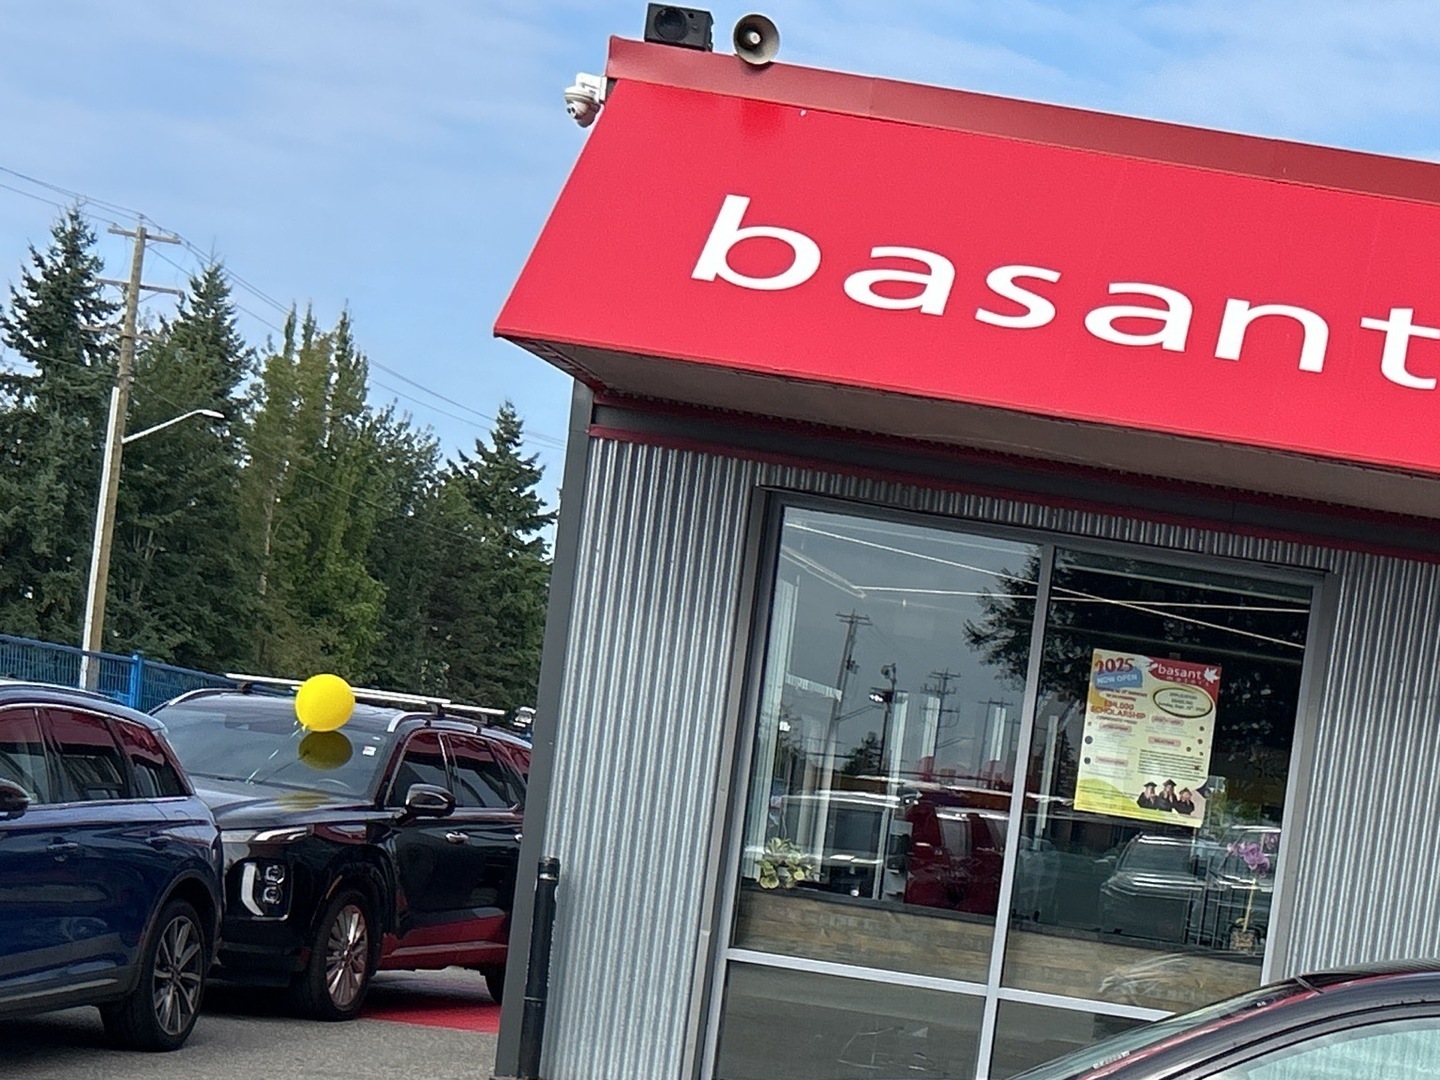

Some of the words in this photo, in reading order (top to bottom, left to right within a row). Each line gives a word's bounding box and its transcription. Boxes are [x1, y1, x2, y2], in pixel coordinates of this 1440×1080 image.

[1095, 657, 1135, 675] 2025
[1158, 663, 1201, 680] basant
[1116, 673, 1138, 683] OPEN
